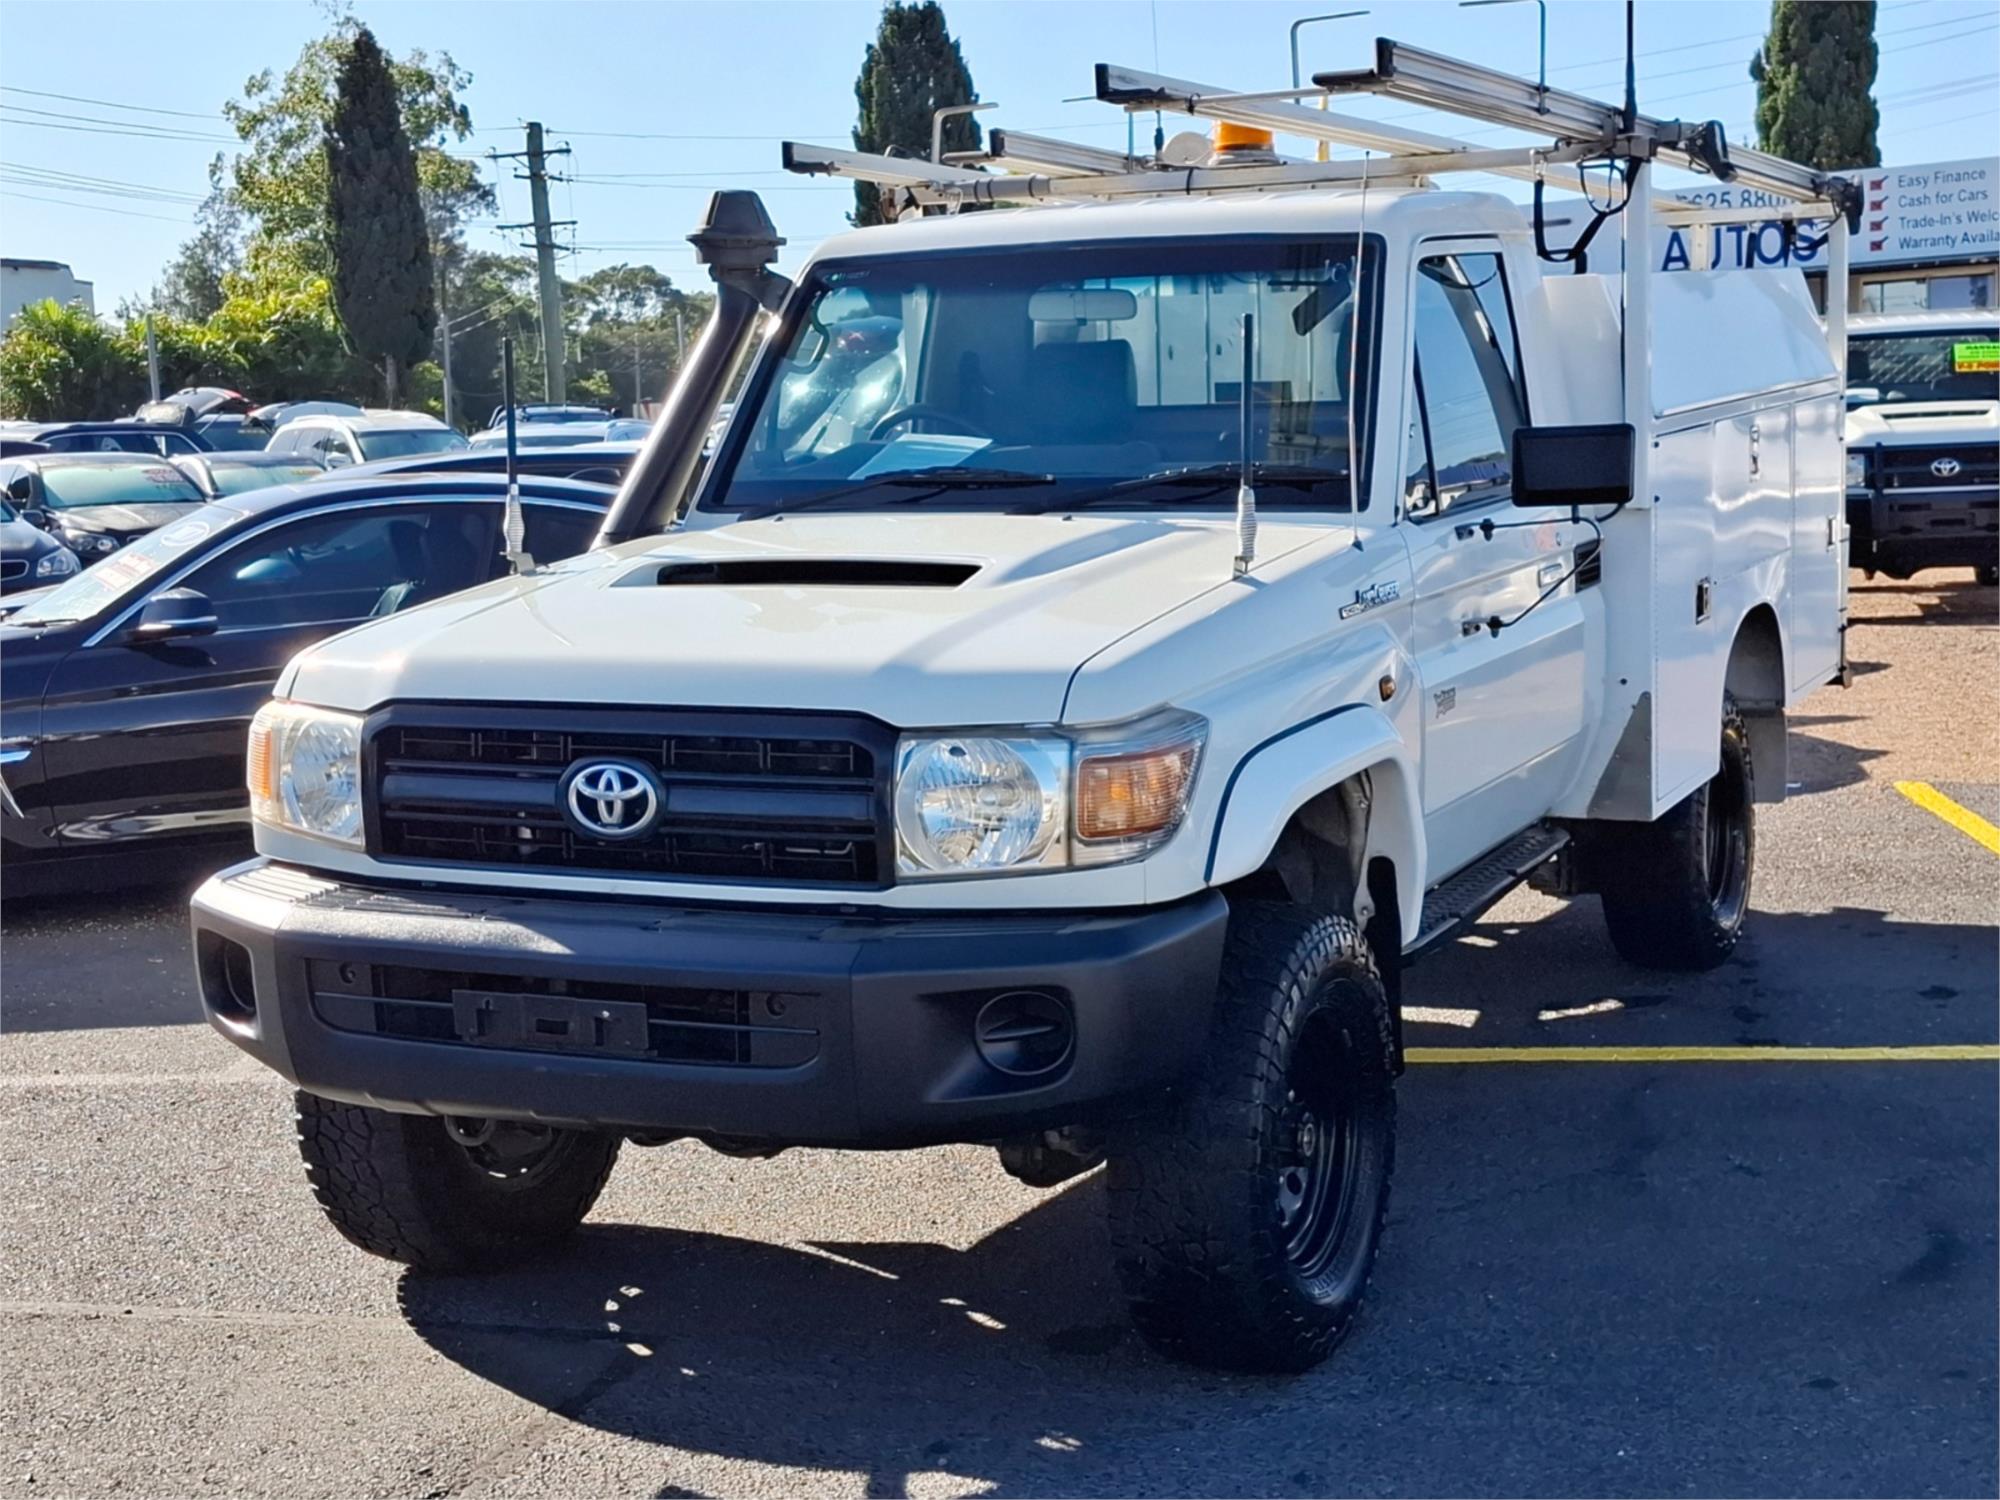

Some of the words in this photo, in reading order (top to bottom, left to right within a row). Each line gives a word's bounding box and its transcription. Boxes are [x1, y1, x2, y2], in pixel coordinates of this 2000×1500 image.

[1898, 174, 1930, 189] Easy
[1934, 170, 1986, 184] Finance
[1898, 193, 1931, 208] Cash
[1935, 191, 1954, 204] for
[1958, 189, 1988, 202] Cars
[1899, 213, 1962, 230] Trade-In's
[1899, 234, 1957, 249] Warranty
